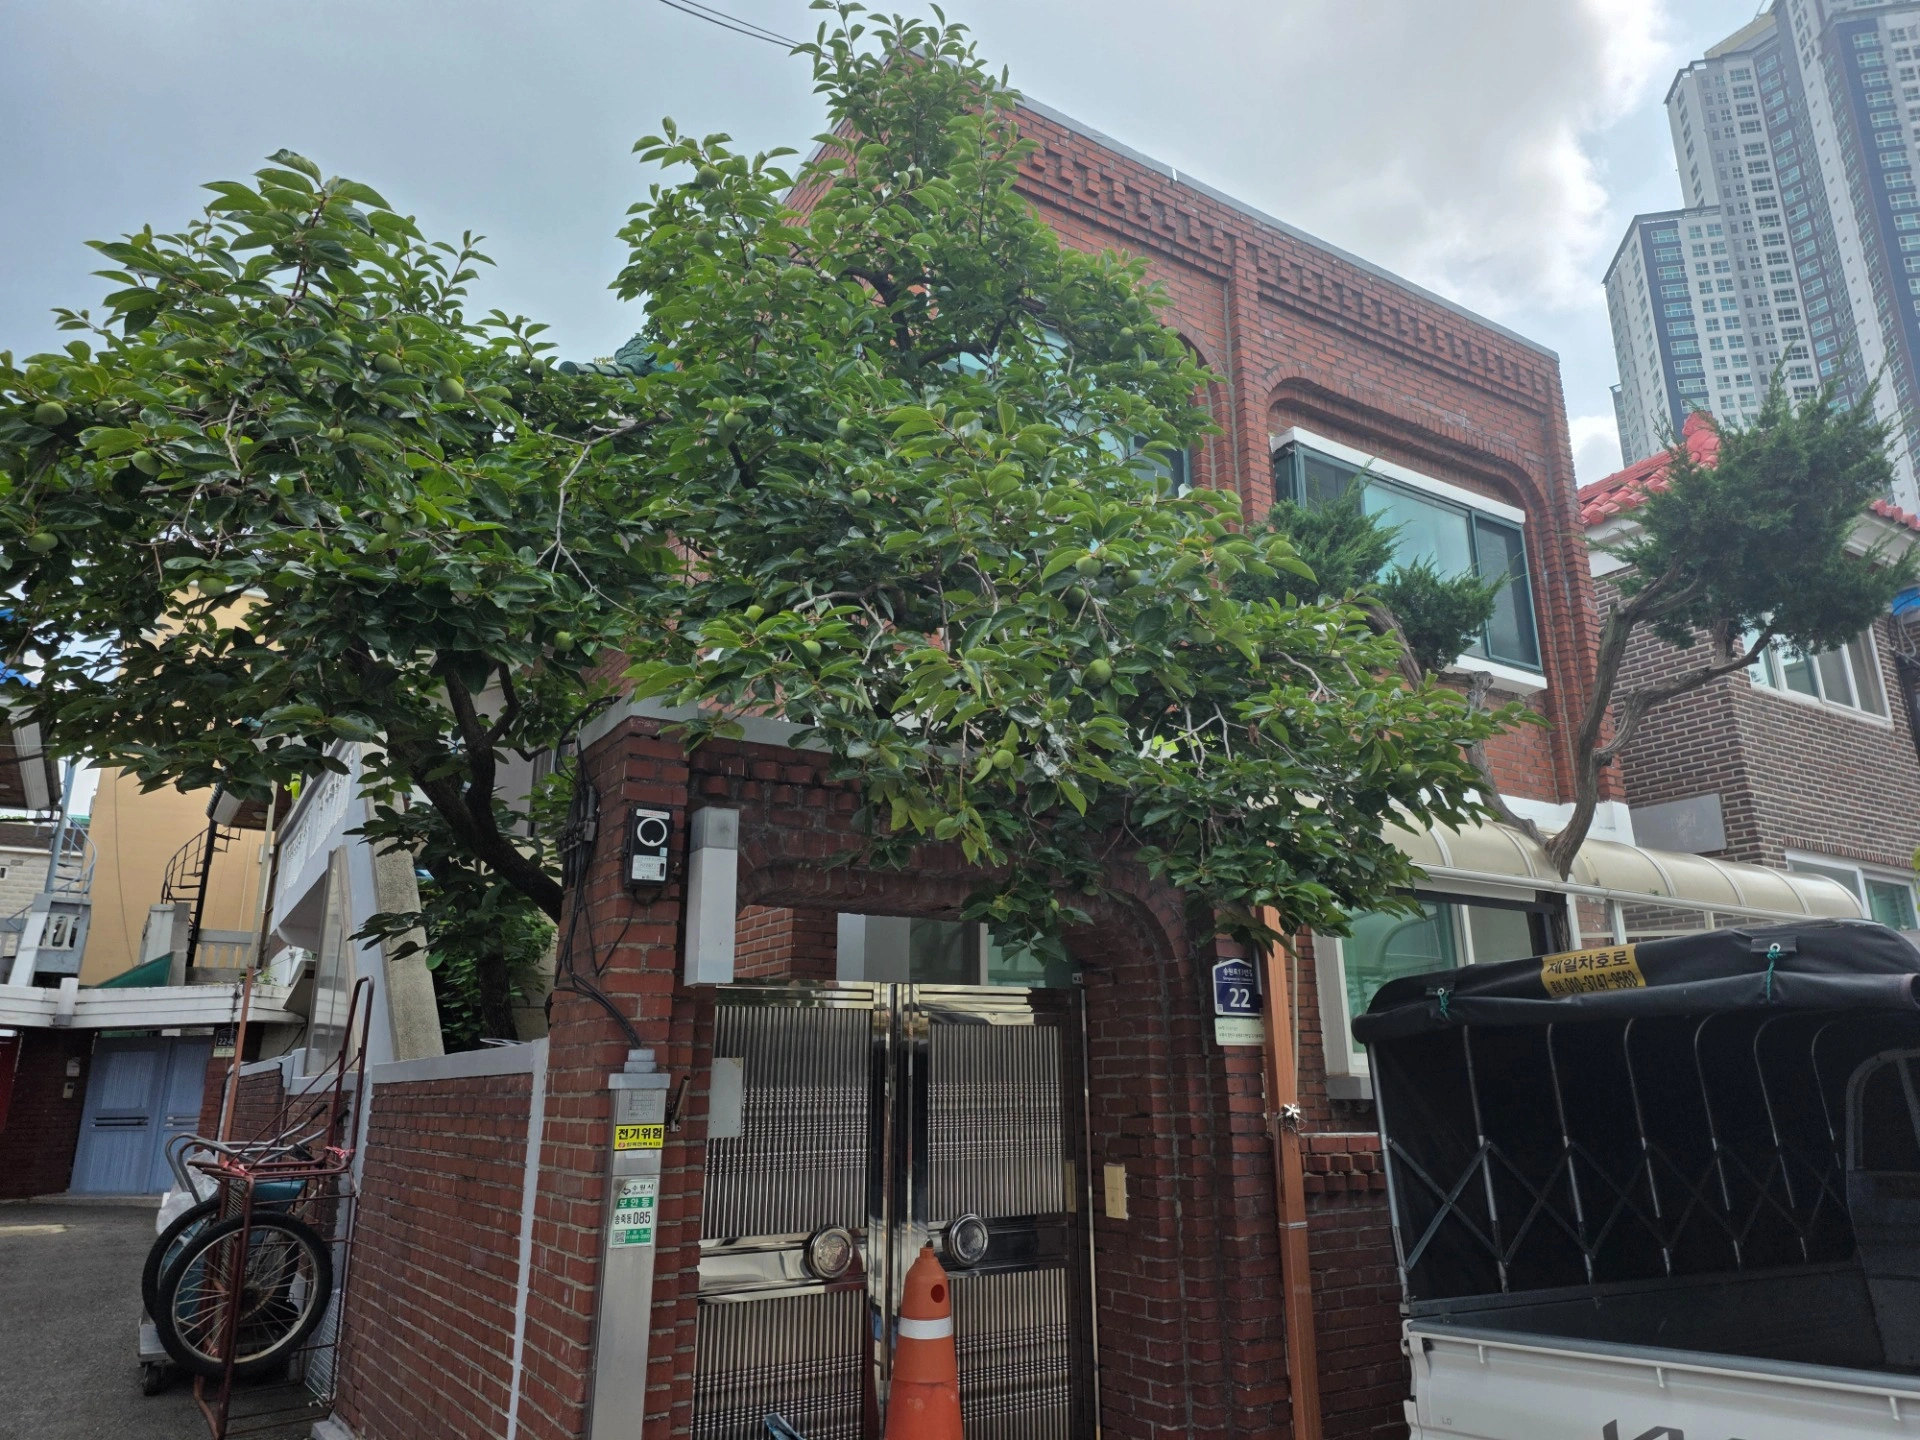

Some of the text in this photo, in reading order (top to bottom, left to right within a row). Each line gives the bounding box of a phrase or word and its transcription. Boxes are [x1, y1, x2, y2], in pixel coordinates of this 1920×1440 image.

[1547, 950, 1630, 974] 제일차호로
[1229, 987, 1251, 1008] 22
[618, 1127, 663, 1140] 전기위험
[619, 1197, 650, 1208] 보안등
[614, 1211, 651, 1225] 송죽동 085
